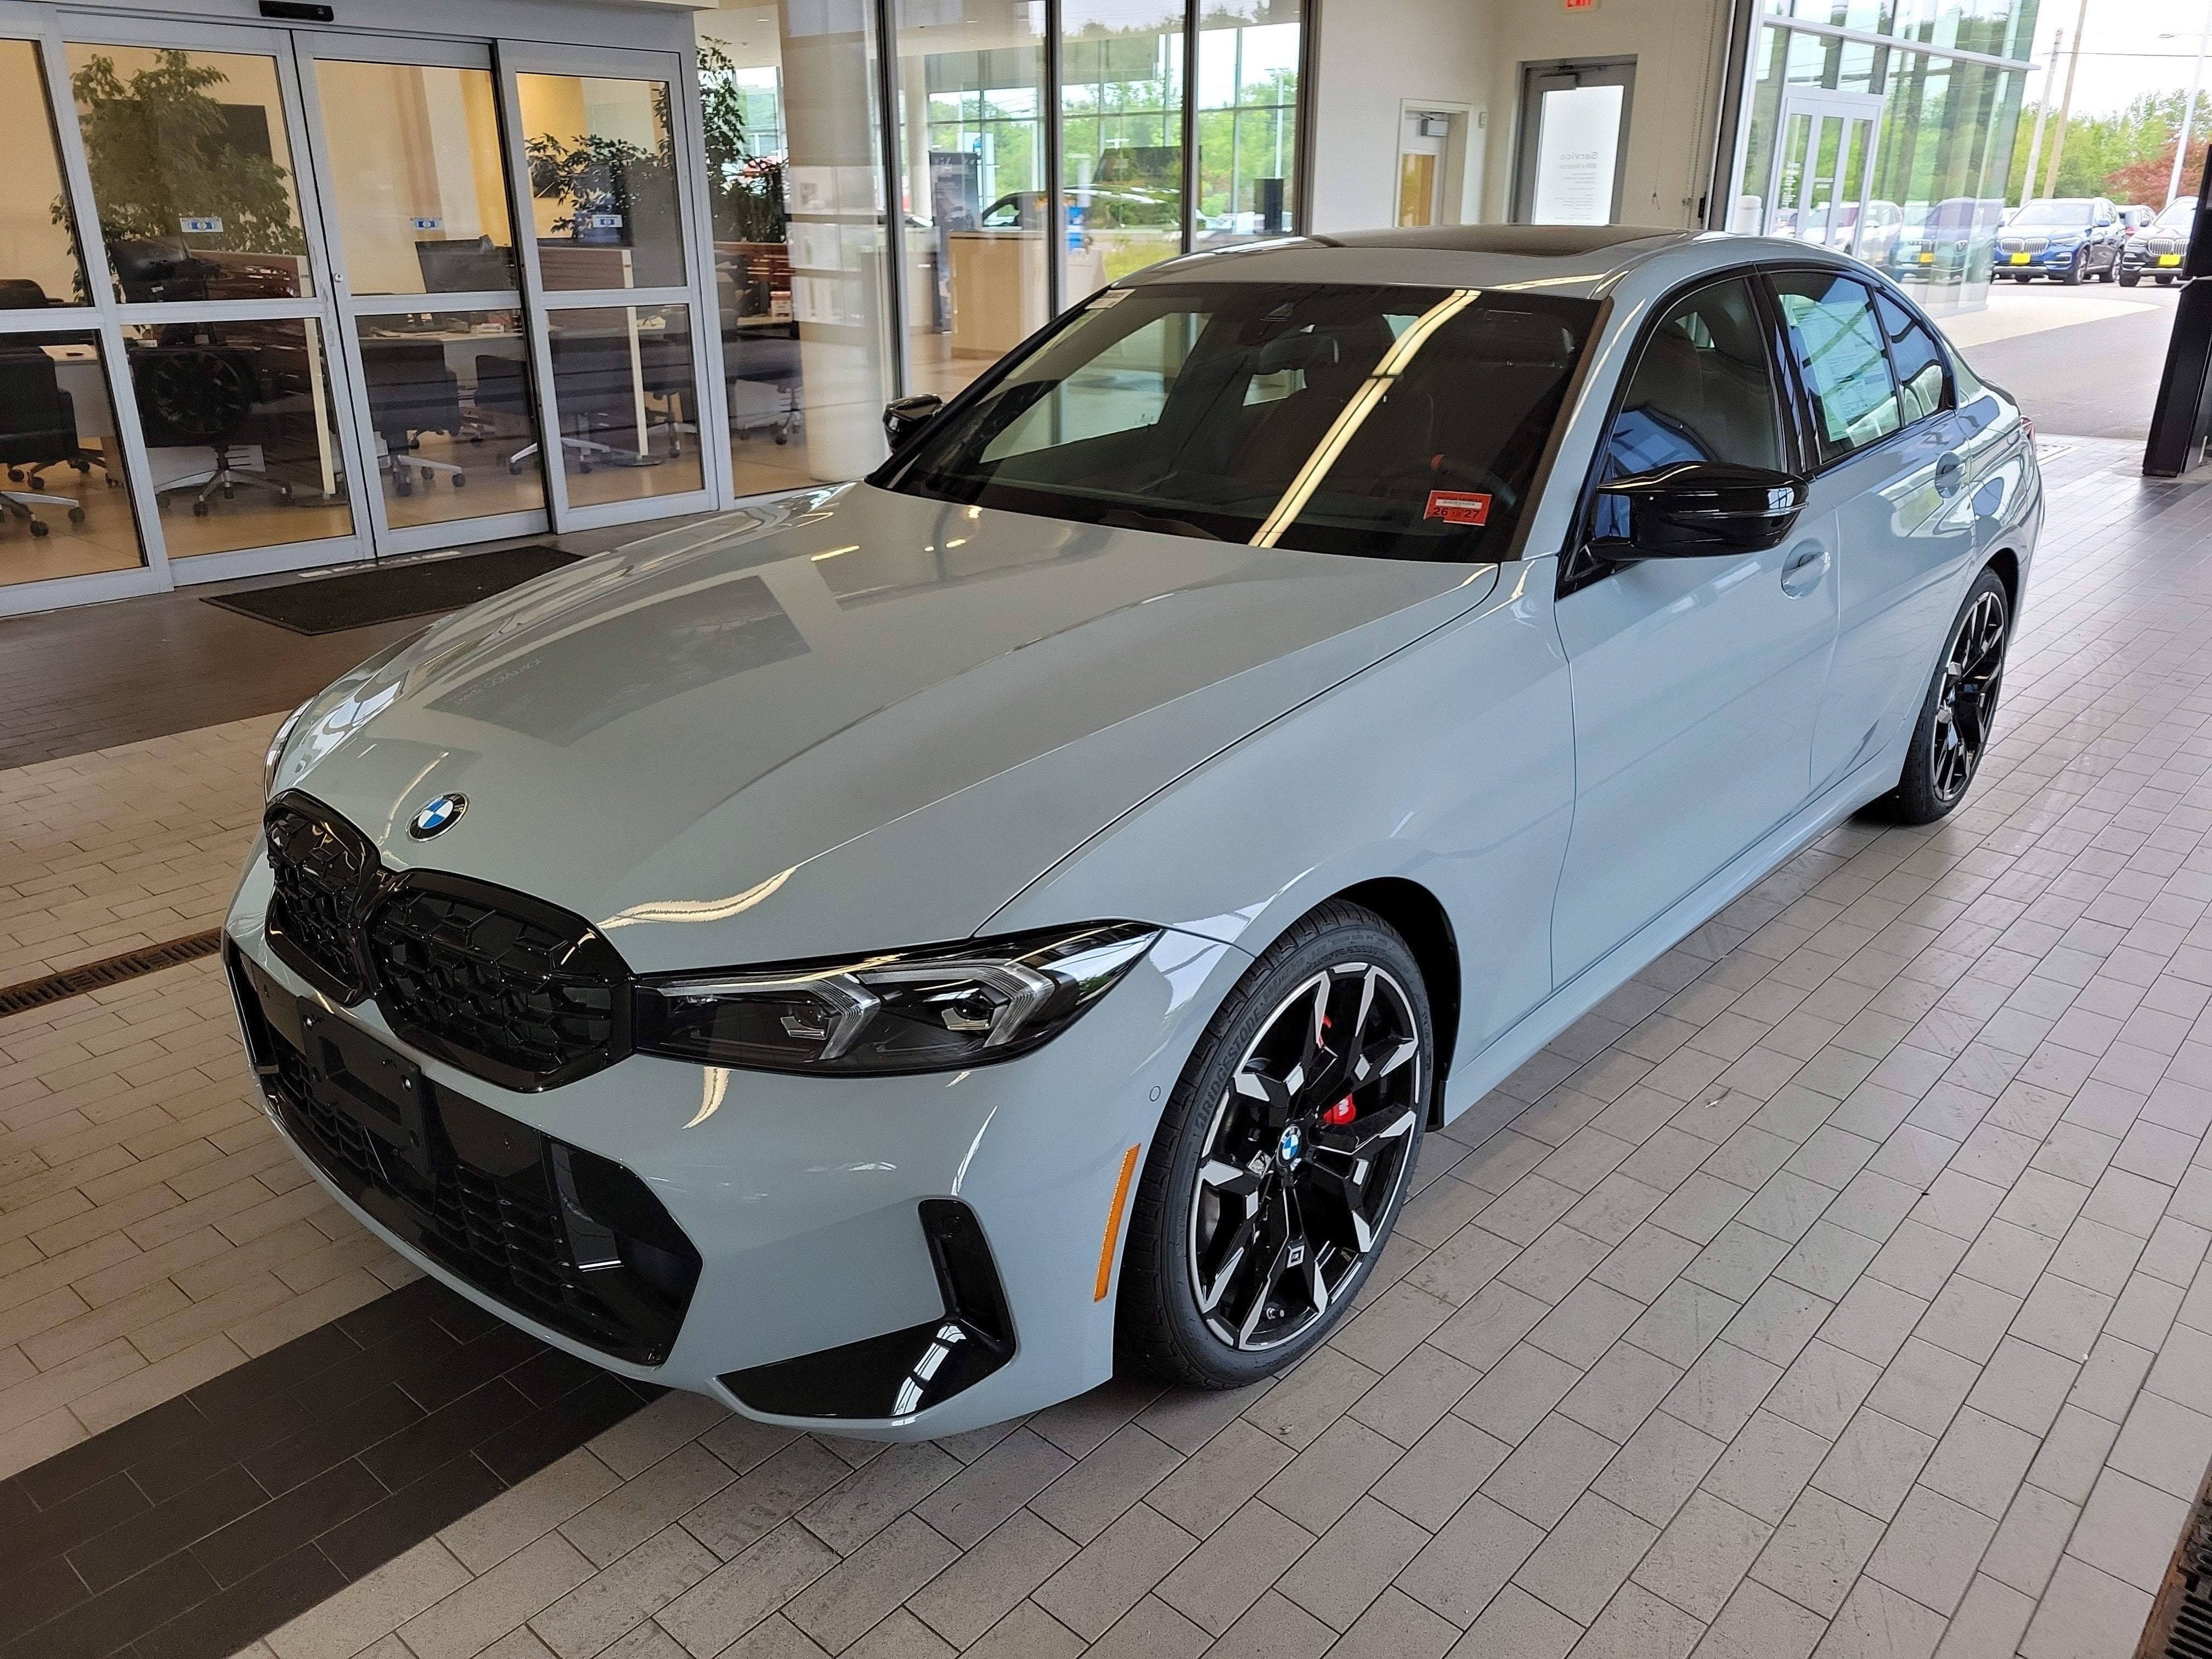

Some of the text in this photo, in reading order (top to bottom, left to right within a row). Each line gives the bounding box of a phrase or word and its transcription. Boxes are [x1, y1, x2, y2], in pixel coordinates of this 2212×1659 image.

[1432, 507, 1449, 516] 26
[1463, 509, 1481, 518] 27
[1195, 1007, 1262, 1131] BRIDGESTONE
